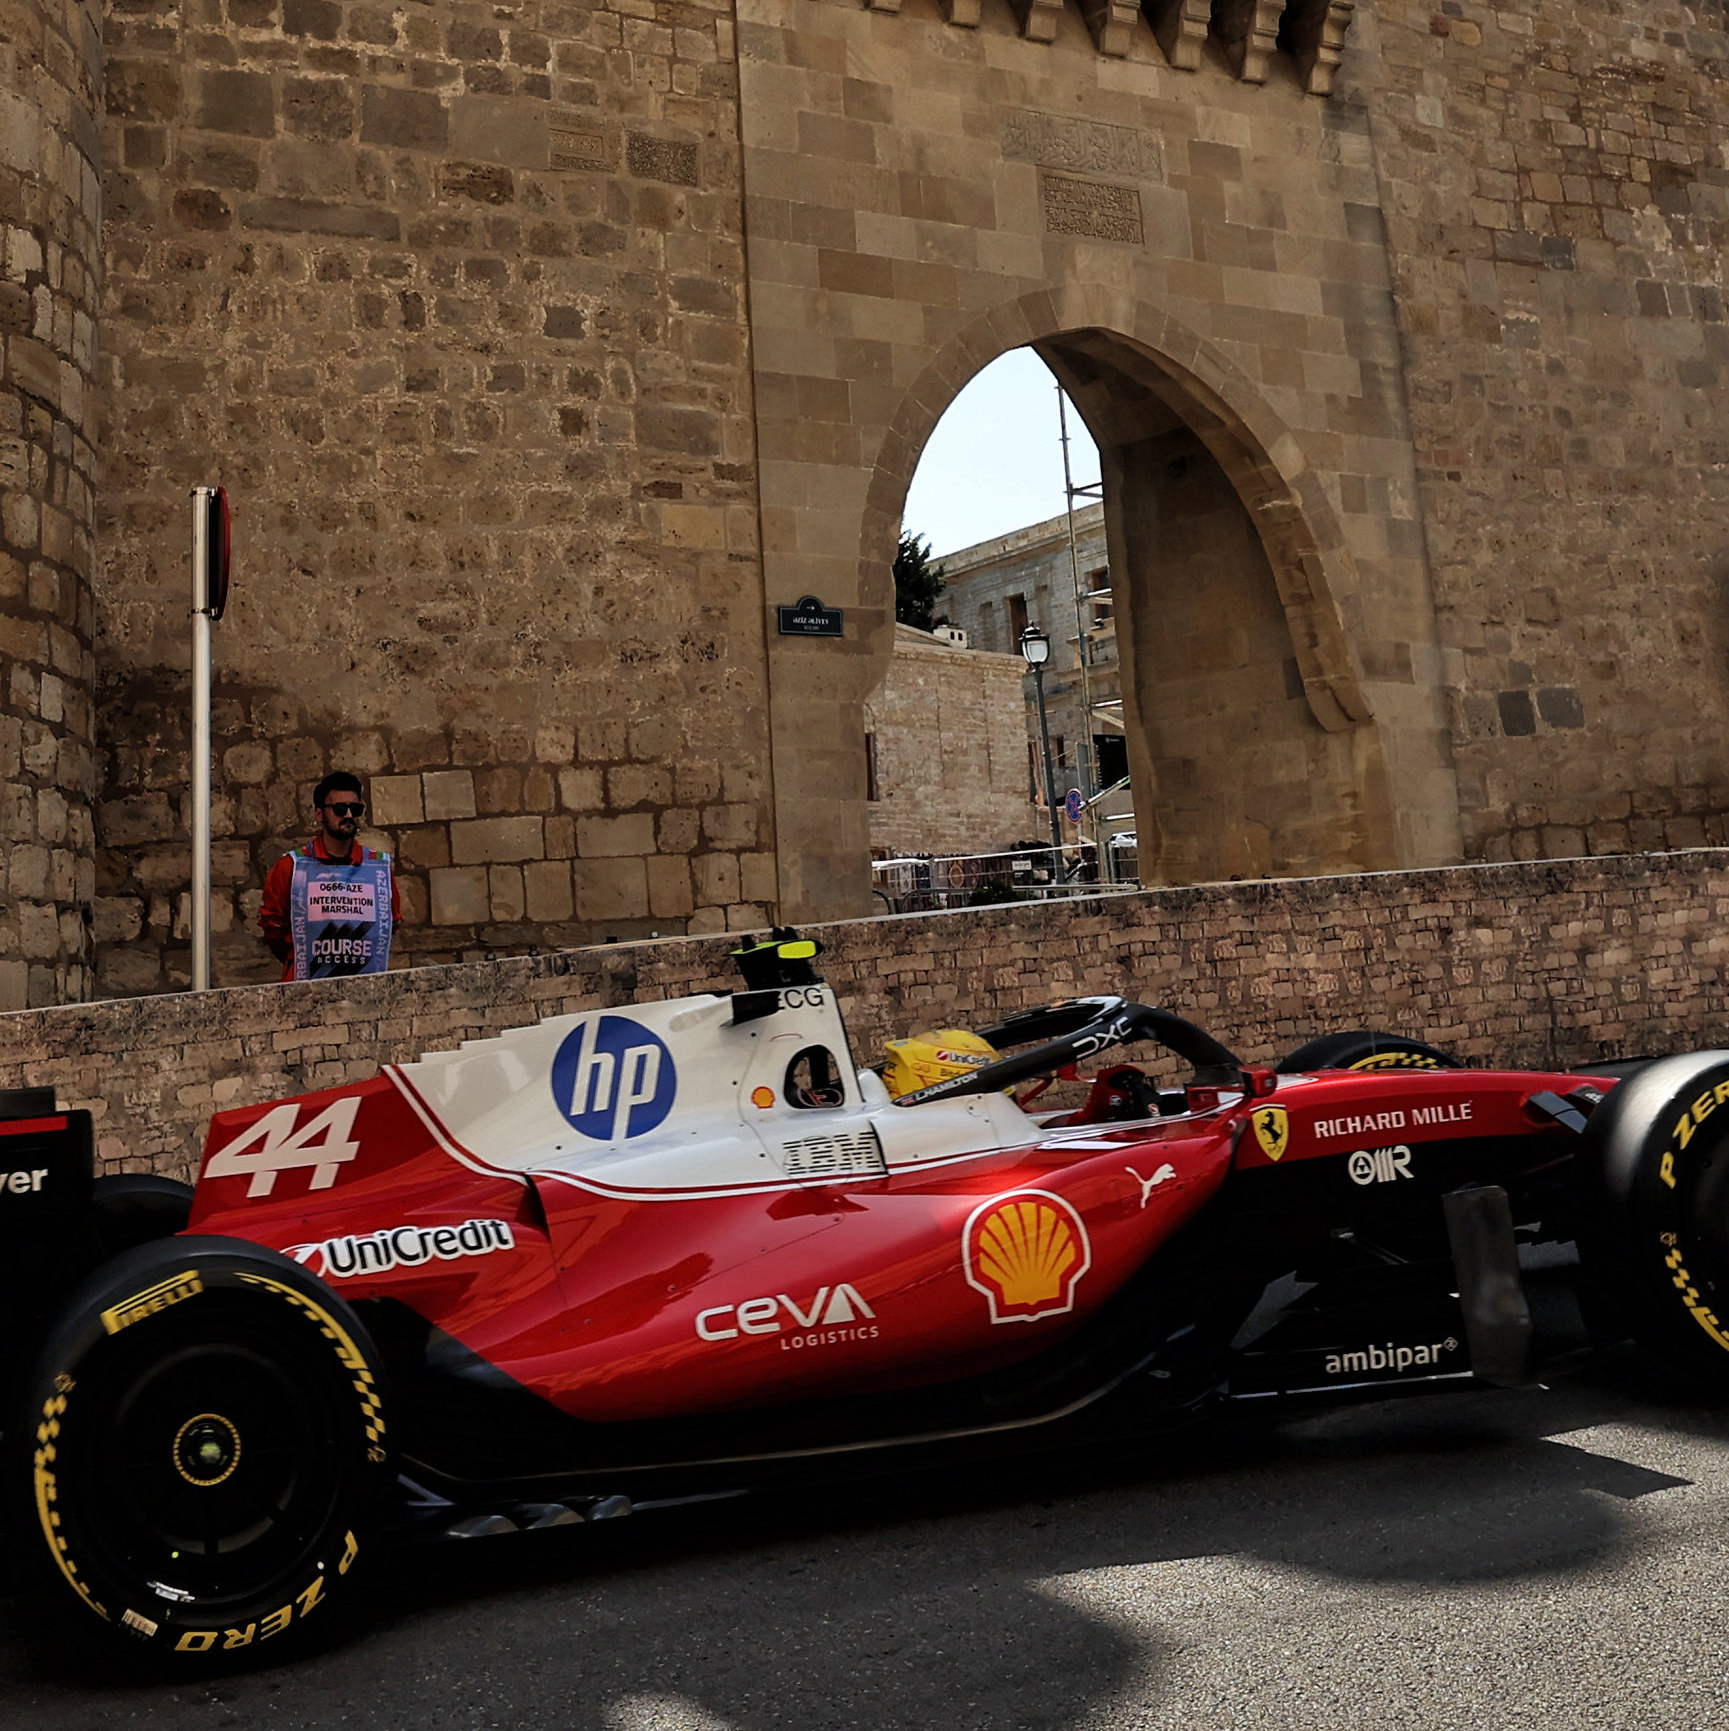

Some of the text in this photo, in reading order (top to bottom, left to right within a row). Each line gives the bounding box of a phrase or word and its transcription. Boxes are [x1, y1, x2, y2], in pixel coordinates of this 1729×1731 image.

[309, 896, 374, 907] INTERVENTION
[321, 905, 364, 915] MARSHAL
[375, 869, 389, 955] AZERBAIJAN
[312, 938, 373, 957] COURSE
[317, 955, 366, 965] ACCESS
[570, 1016, 663, 1141] hp
[1313, 1102, 1473, 1138] RICHARD MILLE
[203, 1096, 362, 1198] 44
[782, 1130, 882, 1176] IBM
[1659, 1150, 1677, 1190] P
[327, 1220, 510, 1273] UniCredit
[99, 1269, 205, 1336] PIRELLI
[780, 1325, 880, 1350] LOGISTICS
[1325, 1342, 1443, 1373] ambipar
[338, 1529, 359, 1575] P
[174, 1575, 326, 1651] ZERO
